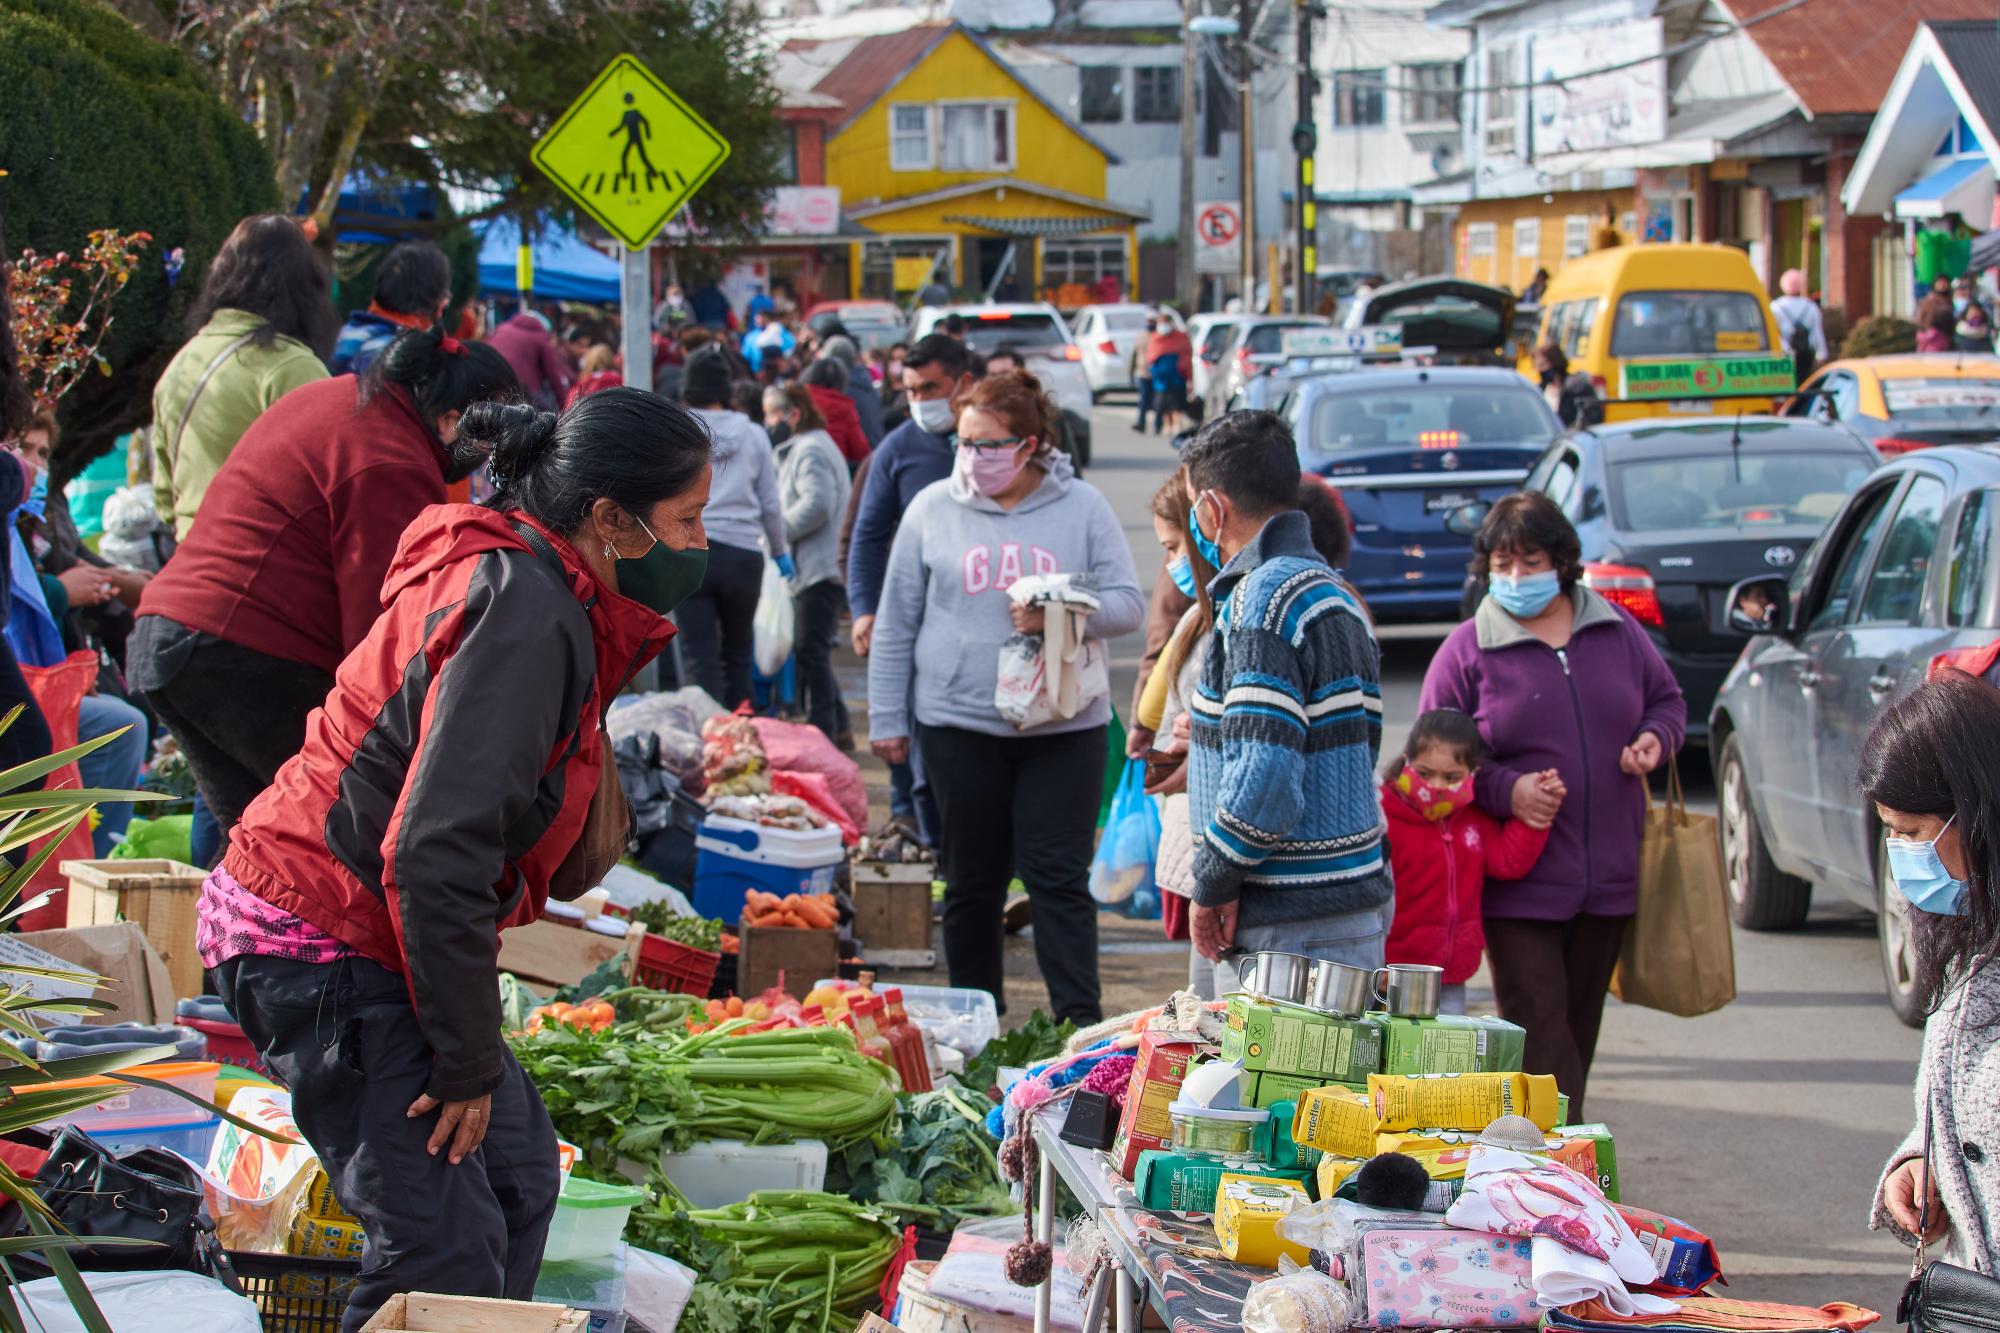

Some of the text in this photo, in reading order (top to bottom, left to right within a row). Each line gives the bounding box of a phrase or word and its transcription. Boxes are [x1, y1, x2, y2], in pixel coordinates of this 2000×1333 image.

[1726, 359, 1792, 377] CENTRO
[963, 541, 1060, 597] GAP
[1306, 1097, 1322, 1143] verdeflor
